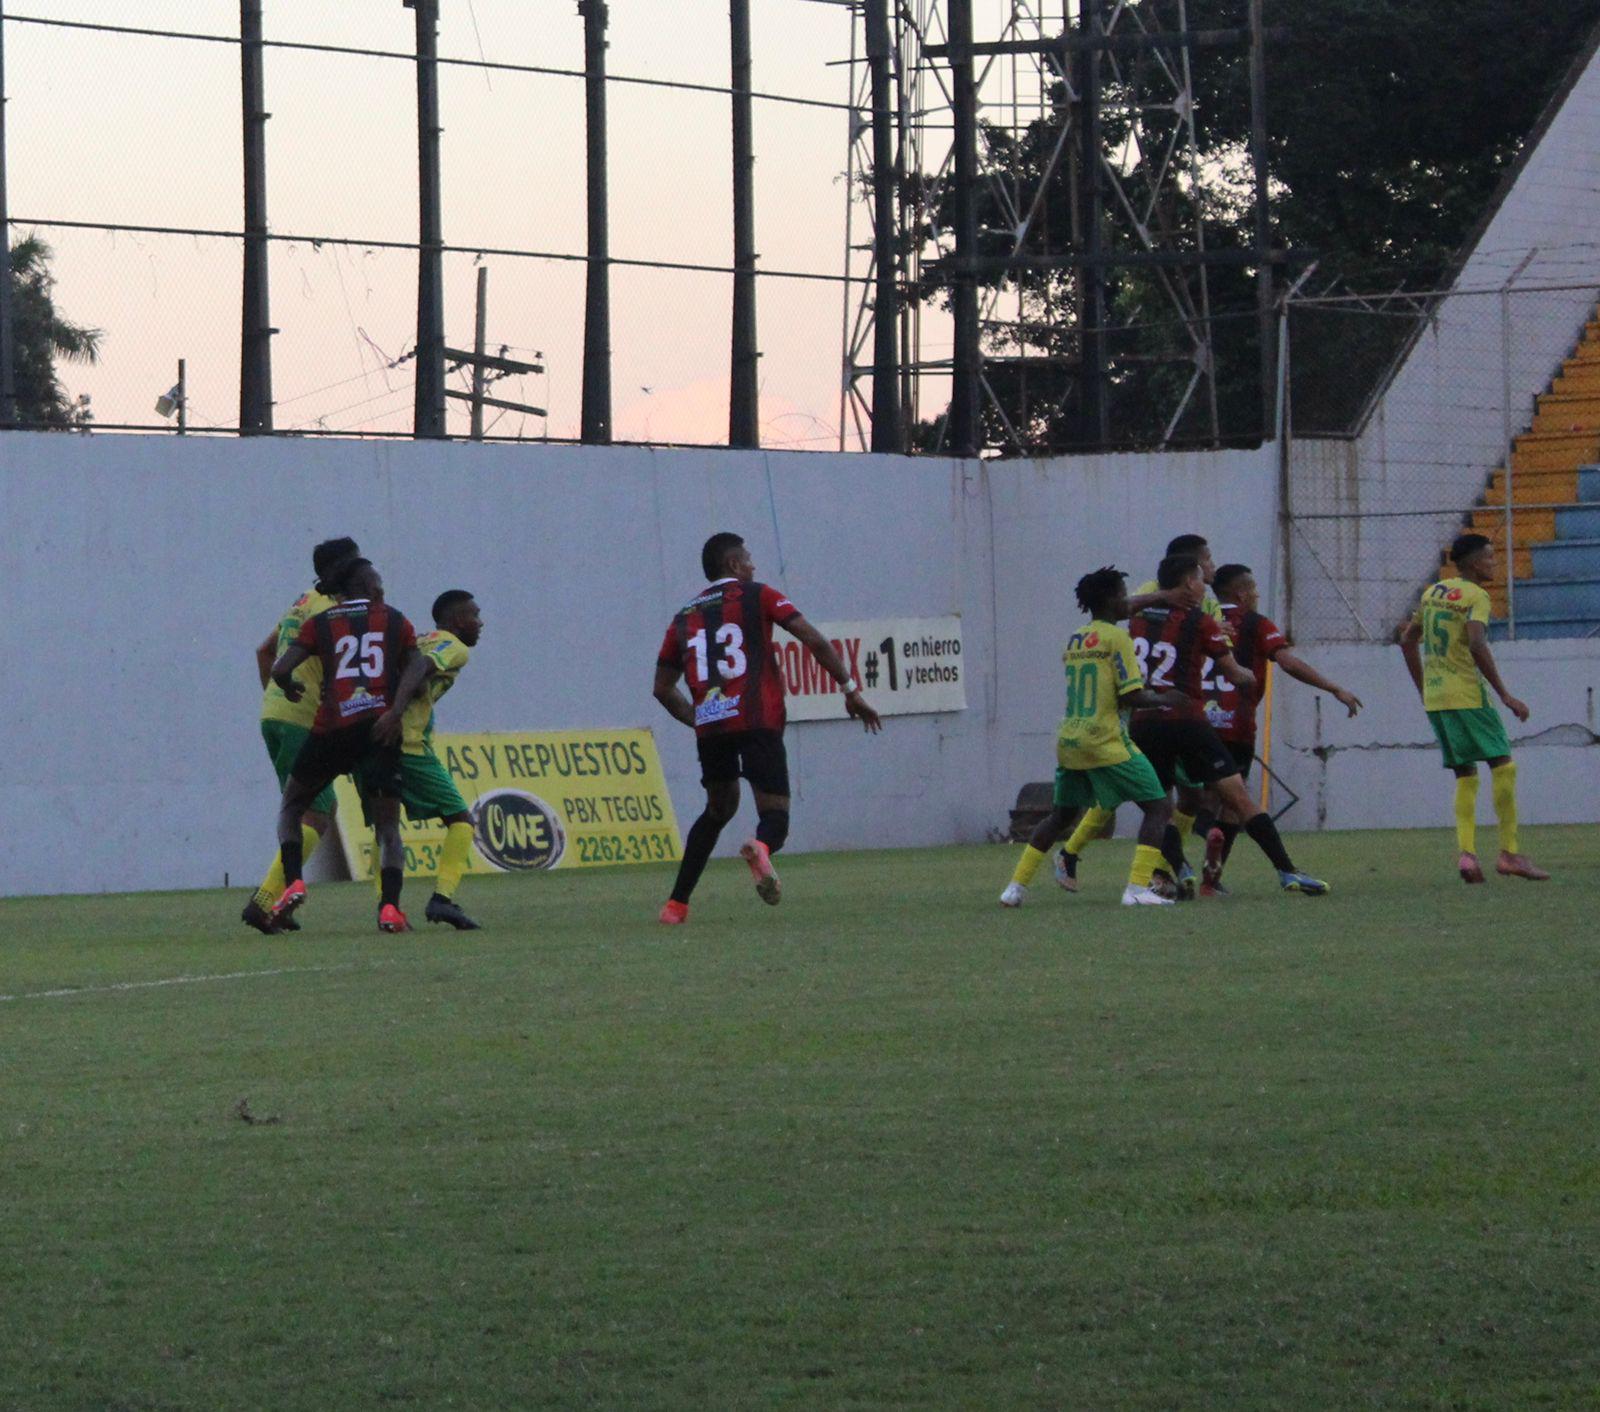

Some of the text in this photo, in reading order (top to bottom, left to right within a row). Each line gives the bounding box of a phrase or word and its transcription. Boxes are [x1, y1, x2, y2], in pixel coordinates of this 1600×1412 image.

[335, 631, 384, 680] 25
[687, 622, 747, 682] 13
[903, 635, 961, 658] en hierro
[905, 662, 959, 689] y techos
[480, 744, 499, 779] Y
[503, 741, 648, 780] REPUESTOS
[563, 794, 665, 824] PBX TEGUS
[487, 803, 549, 852] ONE
[576, 833, 676, 863] 2262-3131
